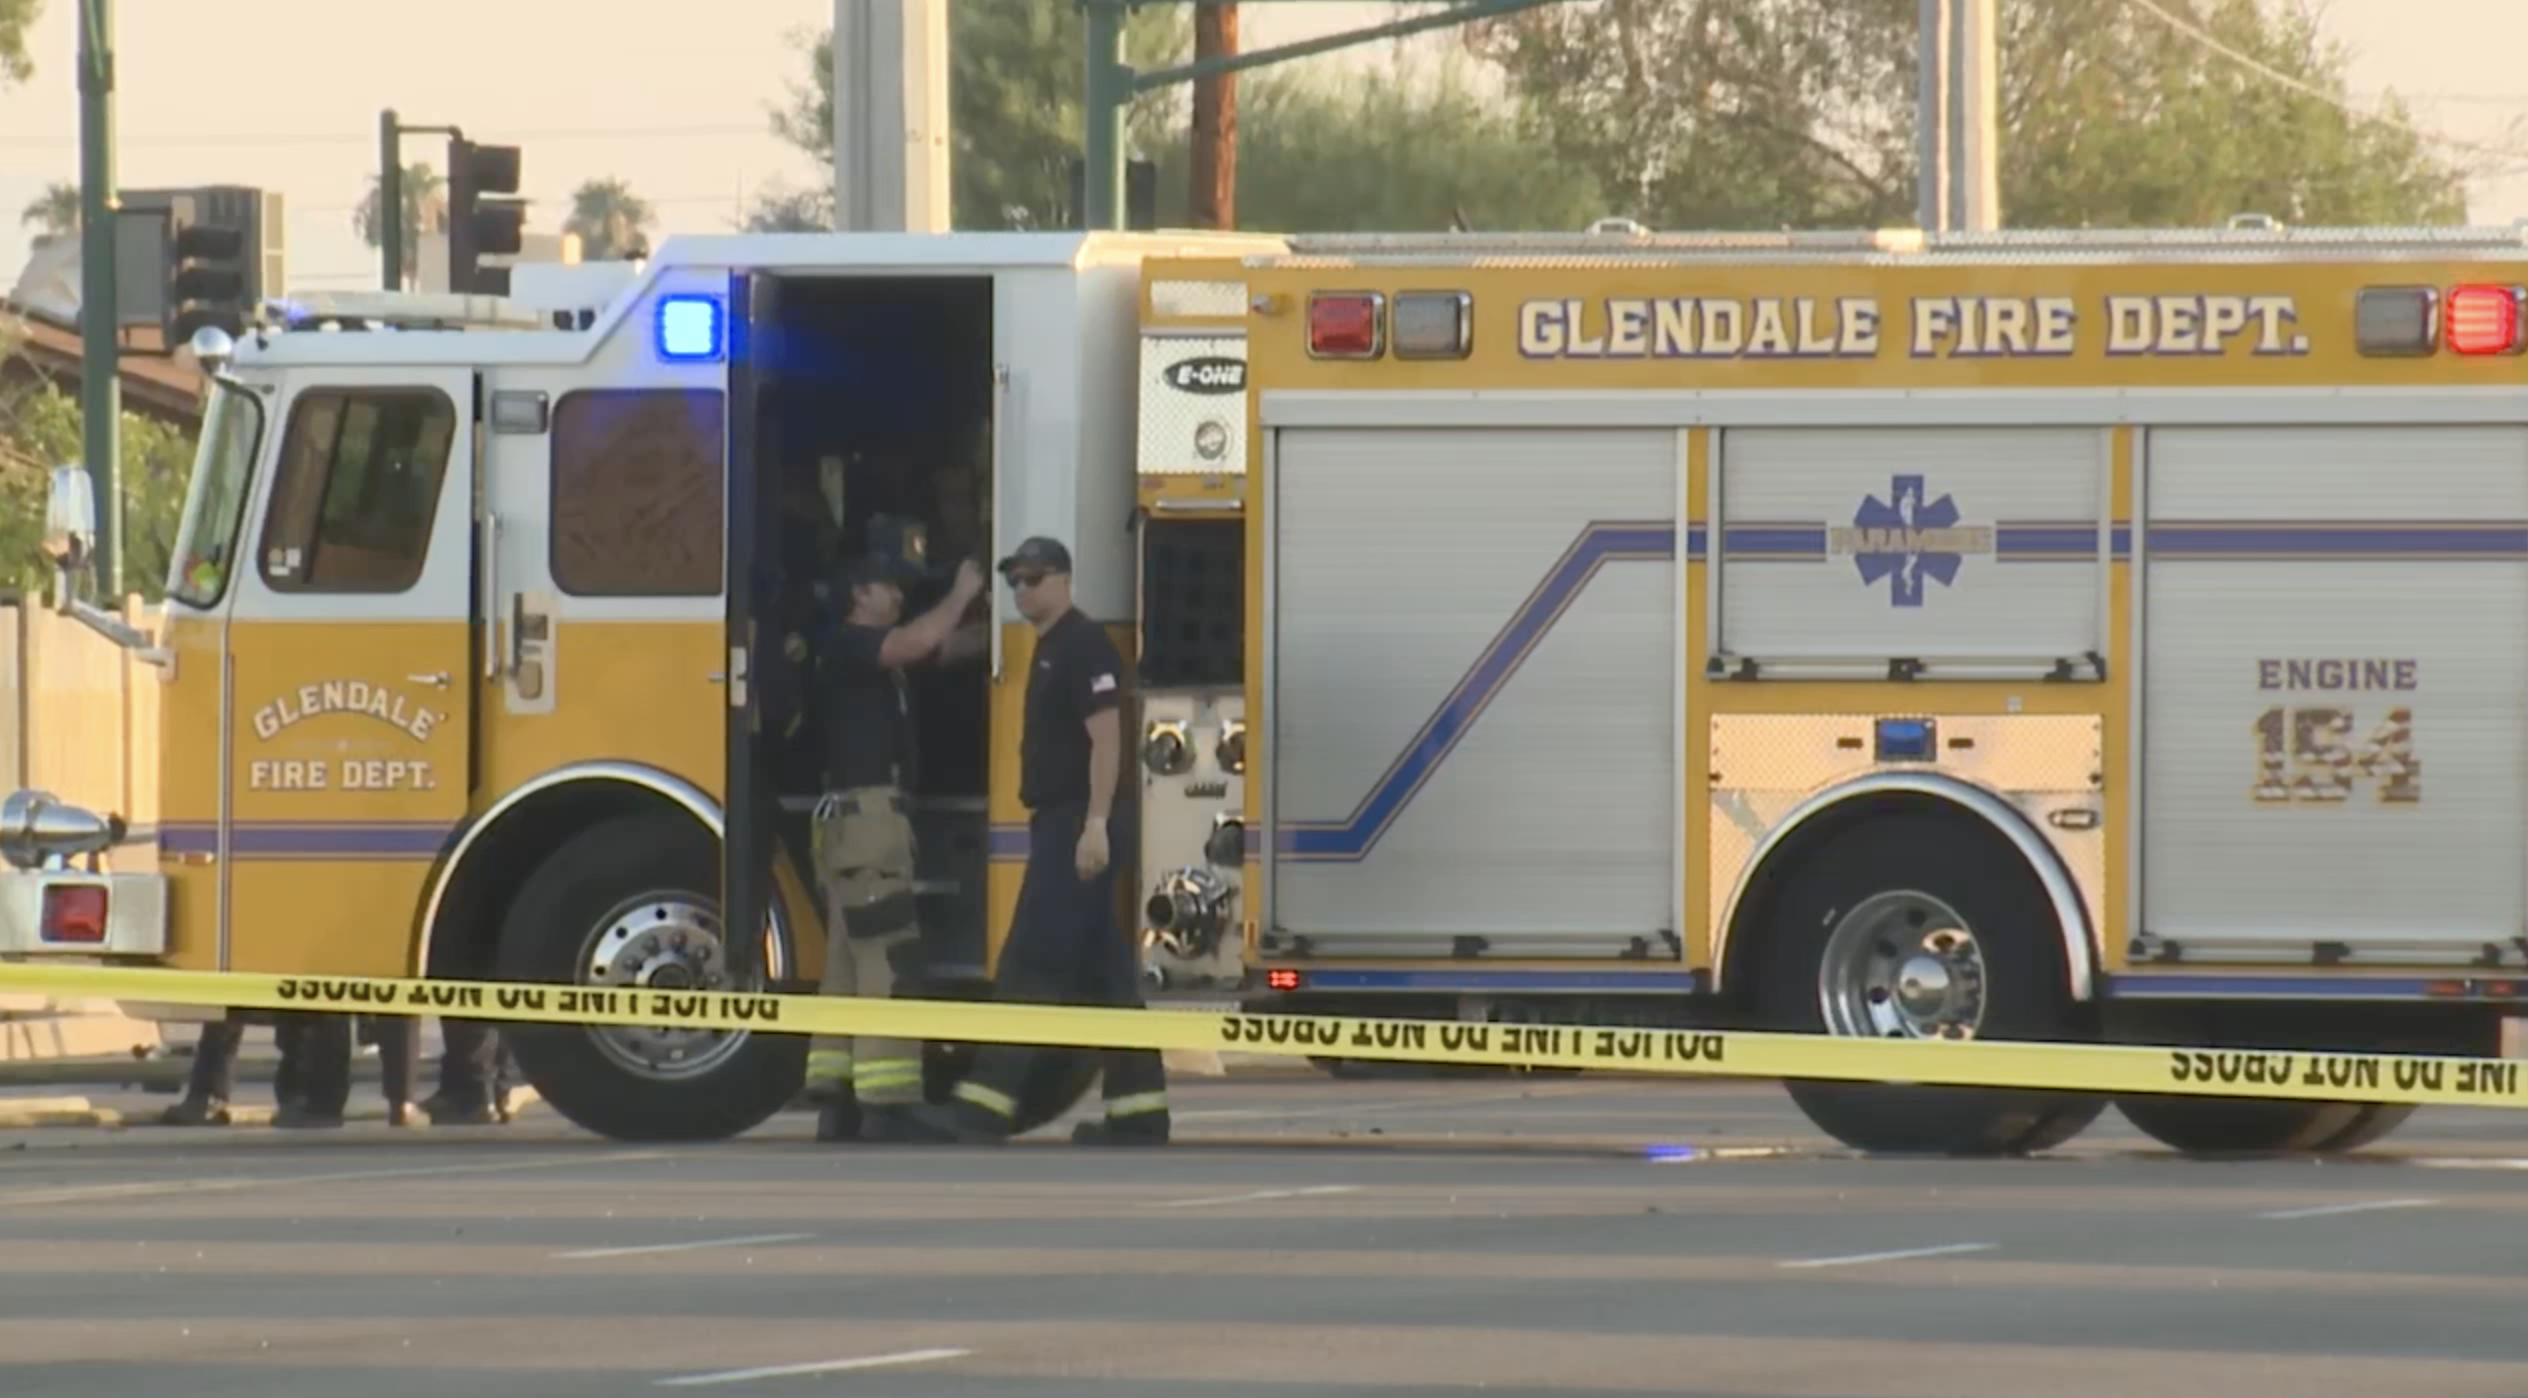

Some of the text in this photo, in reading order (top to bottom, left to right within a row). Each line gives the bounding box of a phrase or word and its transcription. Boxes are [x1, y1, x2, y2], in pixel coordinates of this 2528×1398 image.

[1519, 295, 2310, 359] GLENDALE FIRE DEPT.
[1177, 364, 1243, 385] E-ONE
[2257, 658, 2419, 691] ENGINE
[252, 680, 436, 743] GLENDALE
[2250, 704, 2422, 805] 154
[249, 760, 436, 790] FIRE DEPT.
[407, 983, 483, 1009] NOT
[496, 986, 546, 1012] DO
[1351, 1022, 1425, 1049] NOT
[1441, 1025, 1488, 1052] DO
[2303, 1055, 2378, 1088] NOT
[2395, 1060, 2442, 1090] DO
